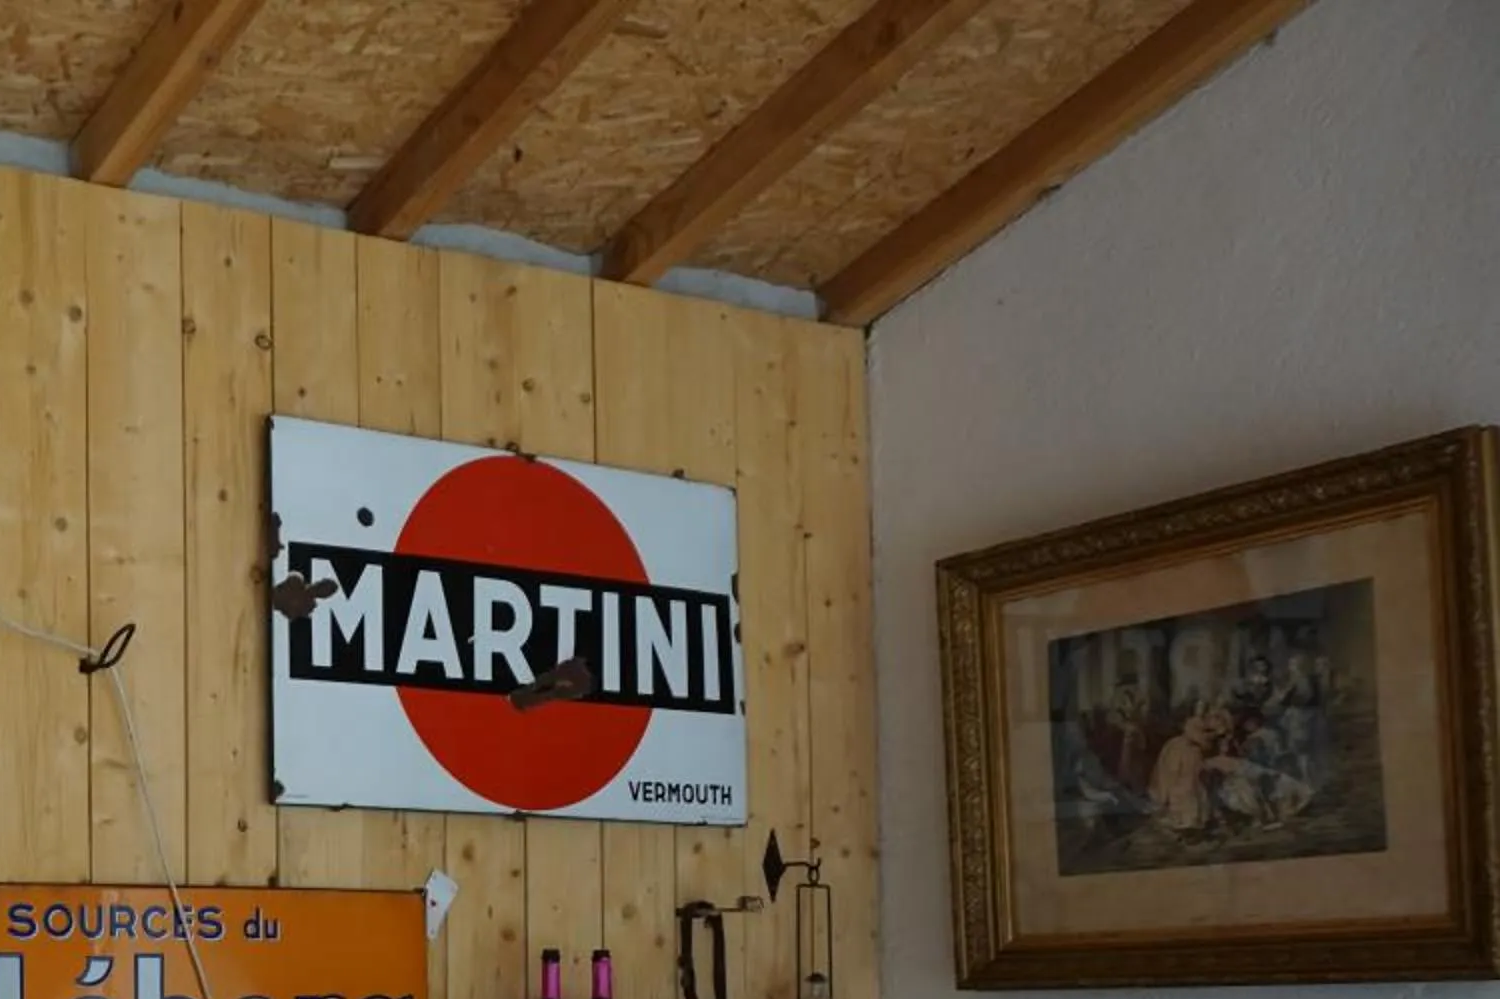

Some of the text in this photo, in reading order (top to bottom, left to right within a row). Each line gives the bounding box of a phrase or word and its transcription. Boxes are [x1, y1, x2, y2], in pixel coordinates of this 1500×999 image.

[309, 556, 721, 702] MARTINI
[627, 780, 733, 806] VERMOUTH
[7, 902, 281, 941] SOURCES du
